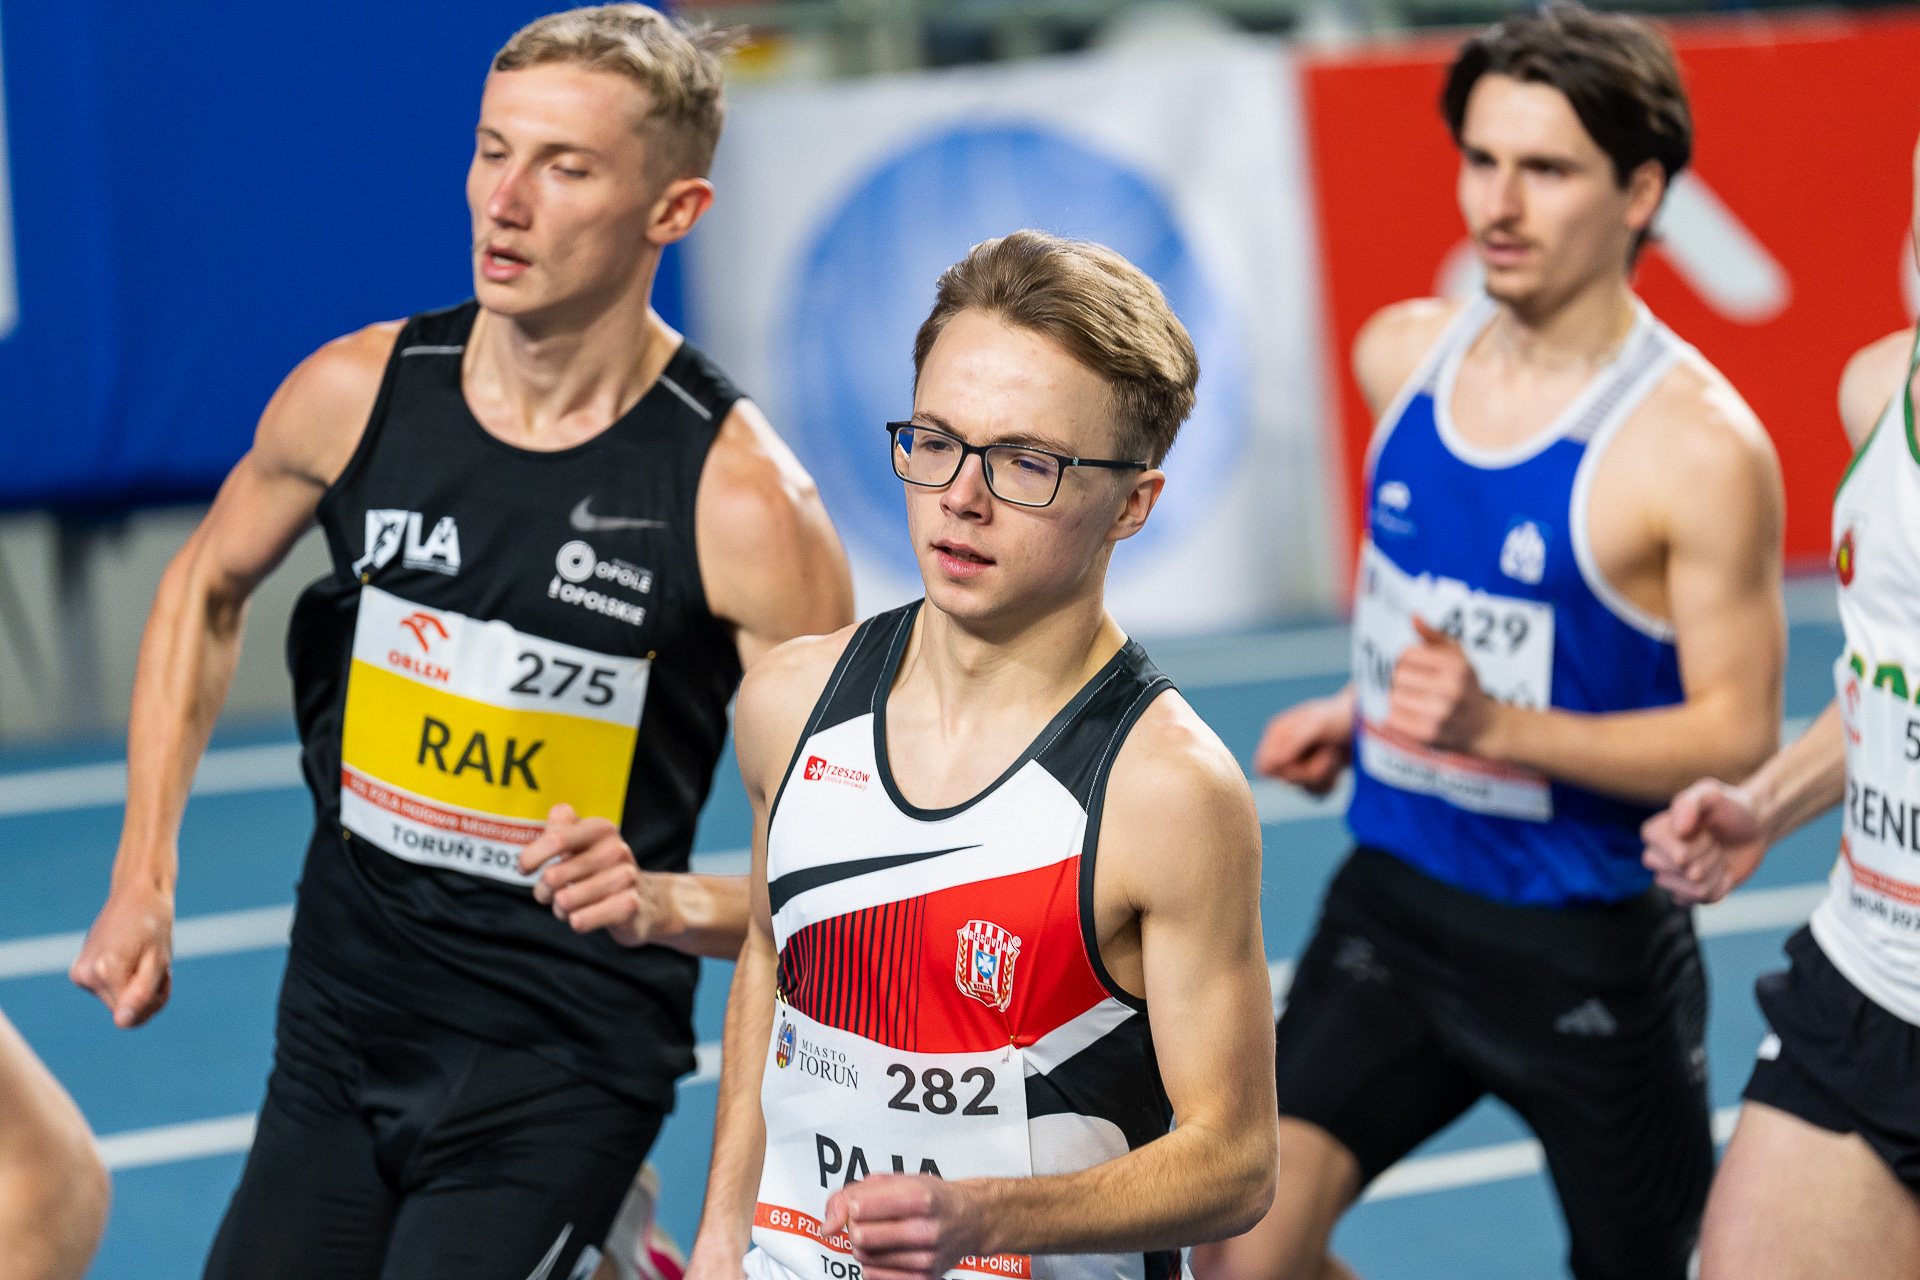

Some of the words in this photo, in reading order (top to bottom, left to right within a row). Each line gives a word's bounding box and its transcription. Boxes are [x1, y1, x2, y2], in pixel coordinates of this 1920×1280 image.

[388, 650, 450, 684] ORLEN
[509, 651, 618, 706] 275
[417, 714, 546, 791] RAK
[968, 930, 1008, 952] RESOVIA
[799, 1050, 859, 1090] TORUŃ
[801, 1039, 847, 1063] MIASTO
[886, 1063, 999, 1116] 282
[769, 1209, 794, 1229] 69.
[980, 1255, 1023, 1275] Polski
[820, 1254, 862, 1280] TOR
